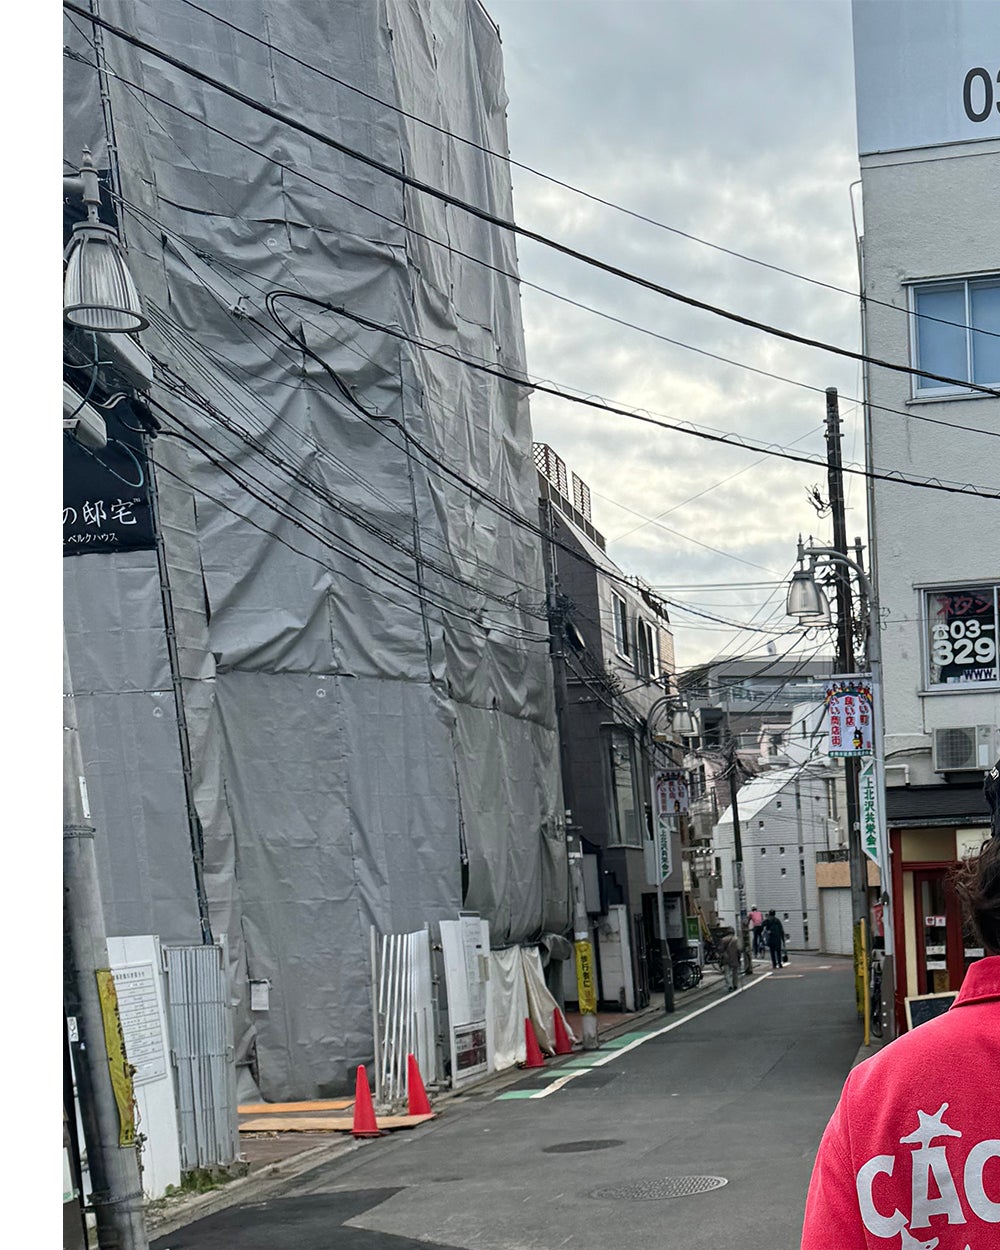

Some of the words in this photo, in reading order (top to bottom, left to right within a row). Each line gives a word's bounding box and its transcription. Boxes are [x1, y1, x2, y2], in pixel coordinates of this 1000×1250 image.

[864, 778, 877, 846] 上北沢共栄会
